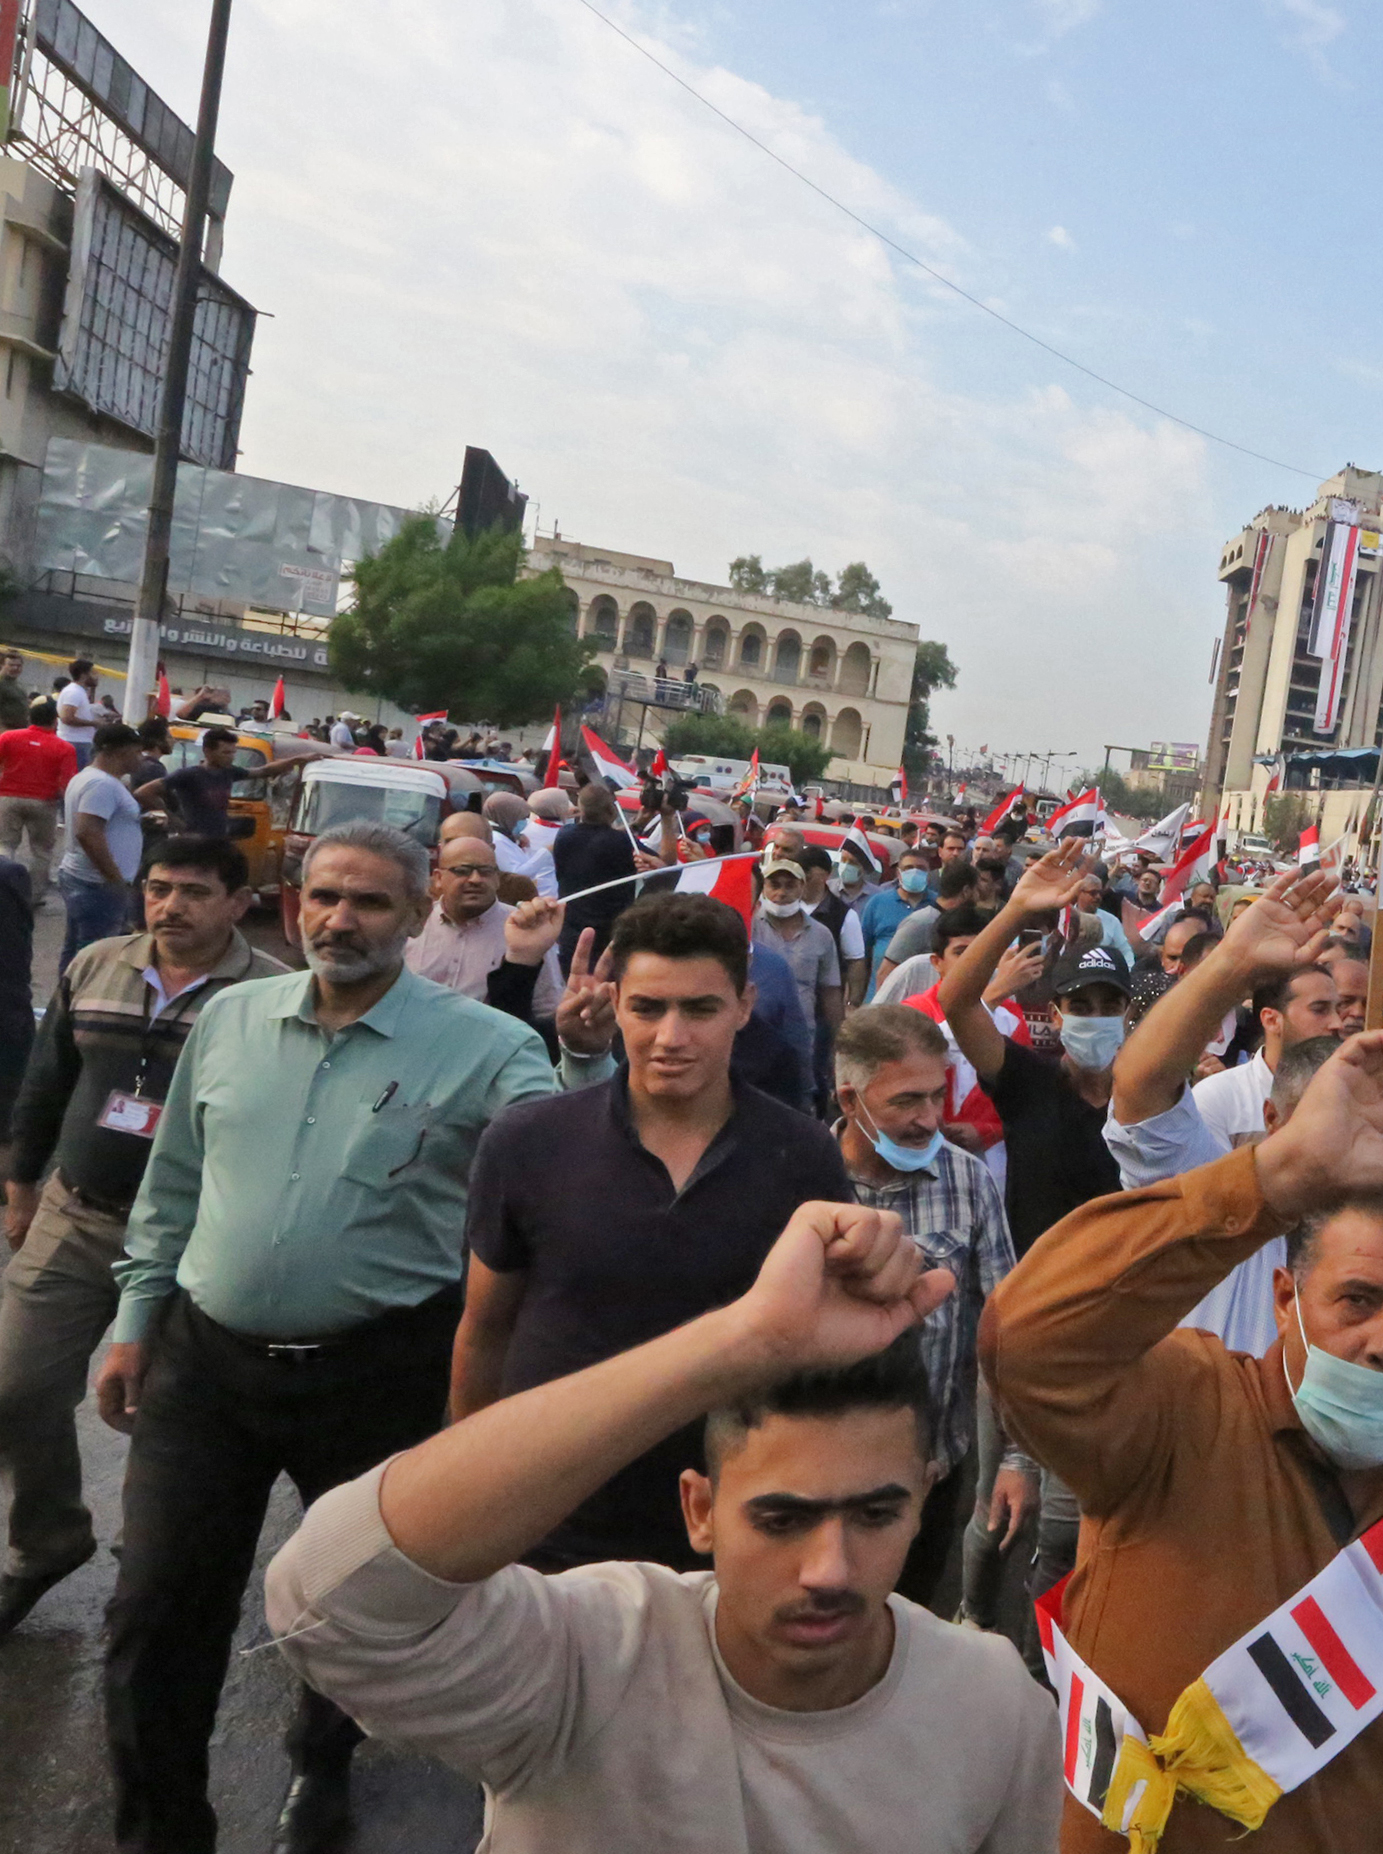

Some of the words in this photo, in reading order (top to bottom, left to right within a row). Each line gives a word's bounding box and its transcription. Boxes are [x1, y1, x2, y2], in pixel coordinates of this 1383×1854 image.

[181, 629, 238, 651] والنشر
[240, 638, 307, 660] للطباعة
[1079, 959, 1116, 970] adidas
